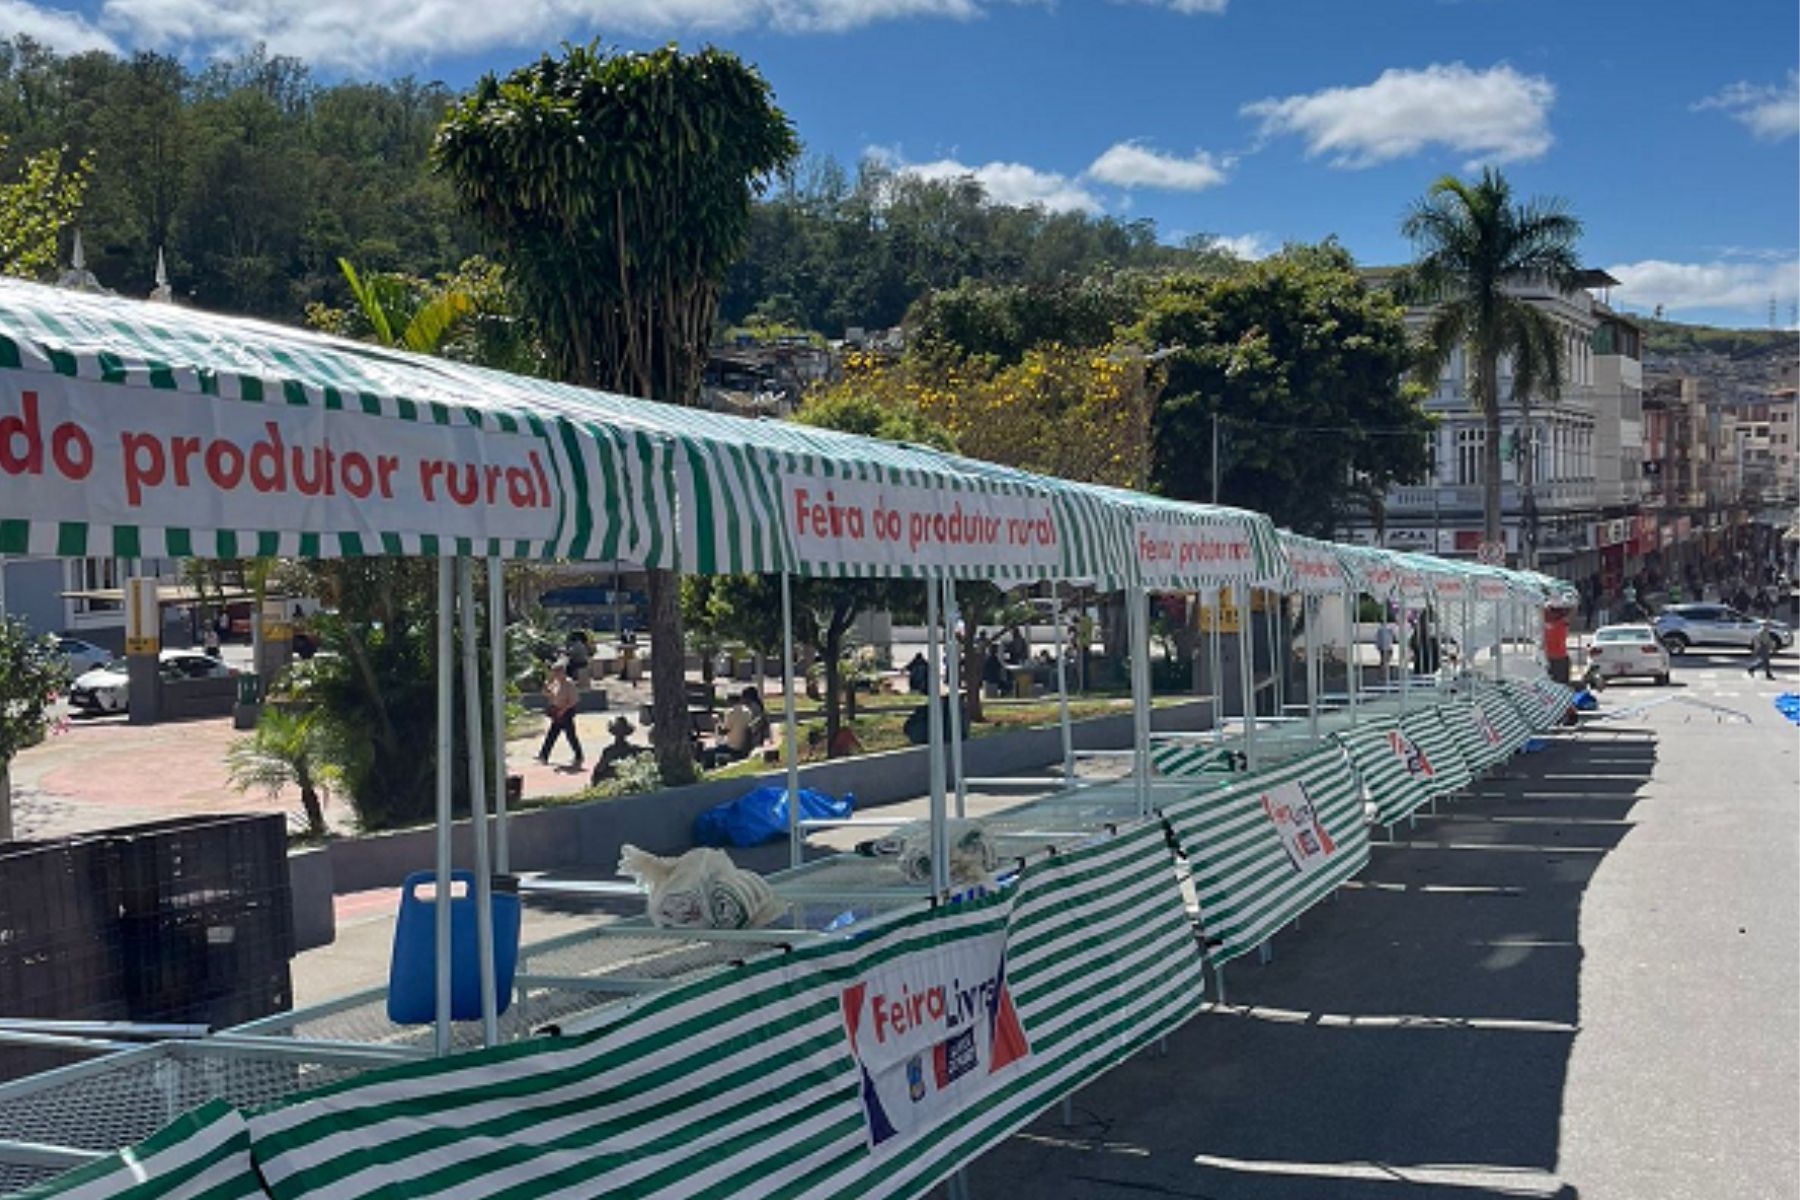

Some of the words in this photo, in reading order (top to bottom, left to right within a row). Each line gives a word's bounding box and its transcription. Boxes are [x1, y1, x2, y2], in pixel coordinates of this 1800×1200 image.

[0, 391, 94, 480] do
[121, 421, 398, 506] produtor
[419, 450, 552, 507] rural
[794, 488, 866, 538] Feira
